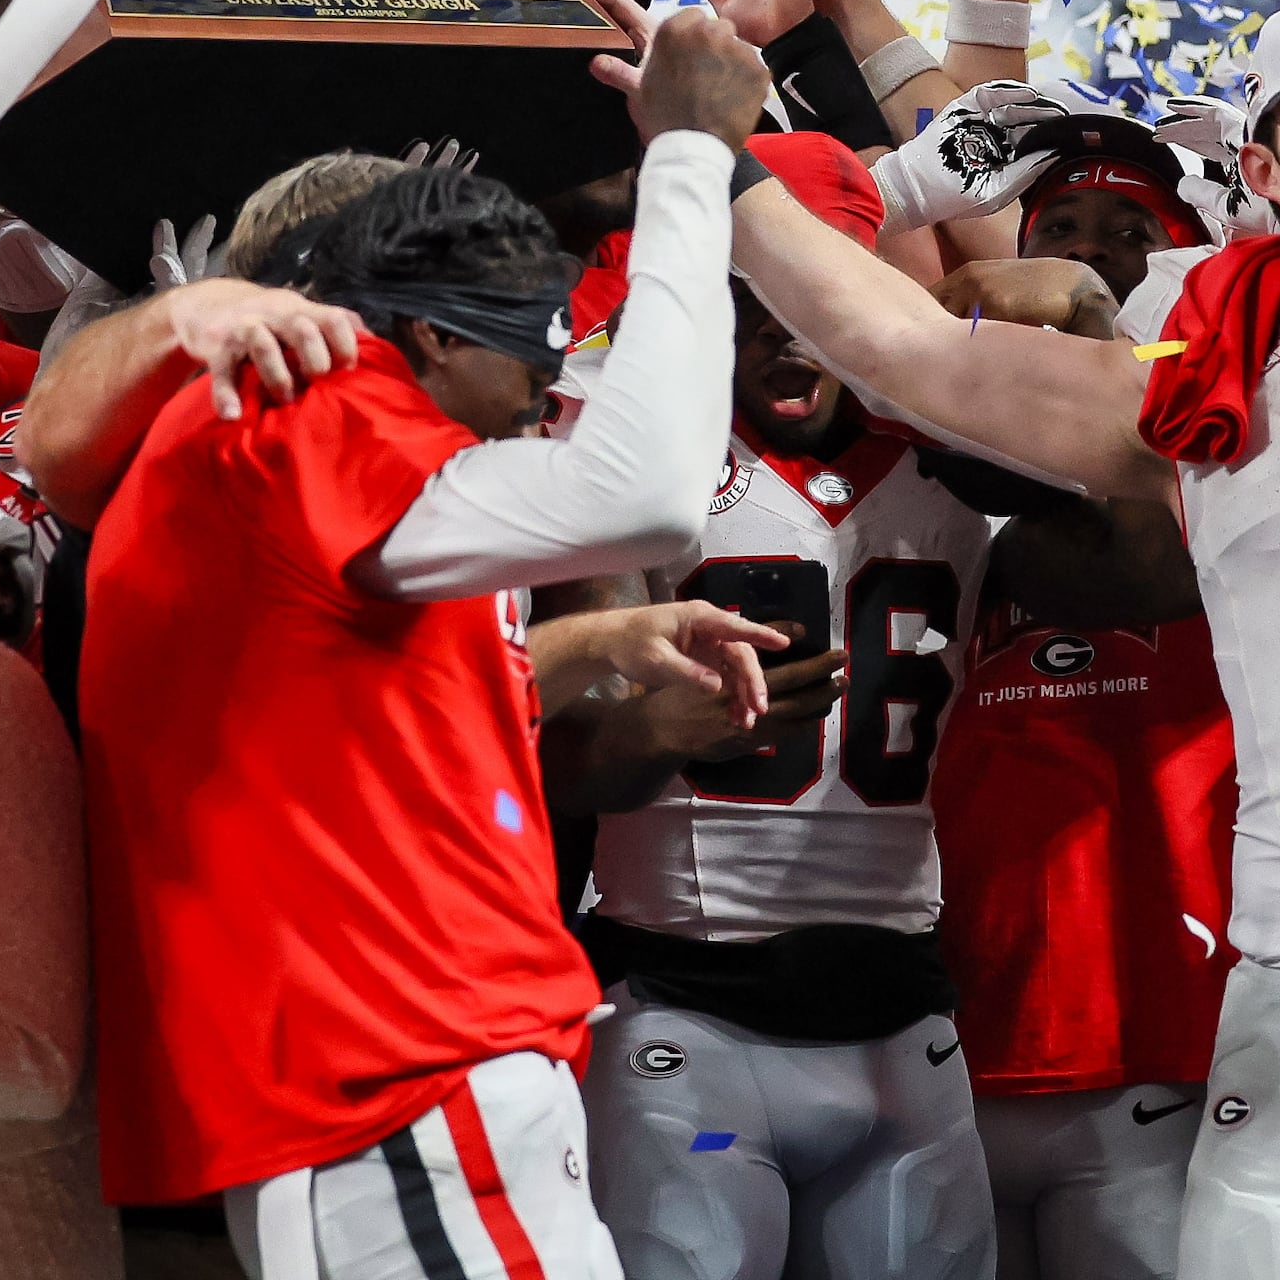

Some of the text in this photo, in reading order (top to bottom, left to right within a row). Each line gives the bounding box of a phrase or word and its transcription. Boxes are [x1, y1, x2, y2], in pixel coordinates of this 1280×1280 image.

[346, 8, 408, 19] CHAMPION
[1039, 639, 1093, 672] G
[978, 676, 1149, 707] IT JUST MEANS MORE
[639, 1044, 686, 1072] G
[1217, 1099, 1250, 1122] G
